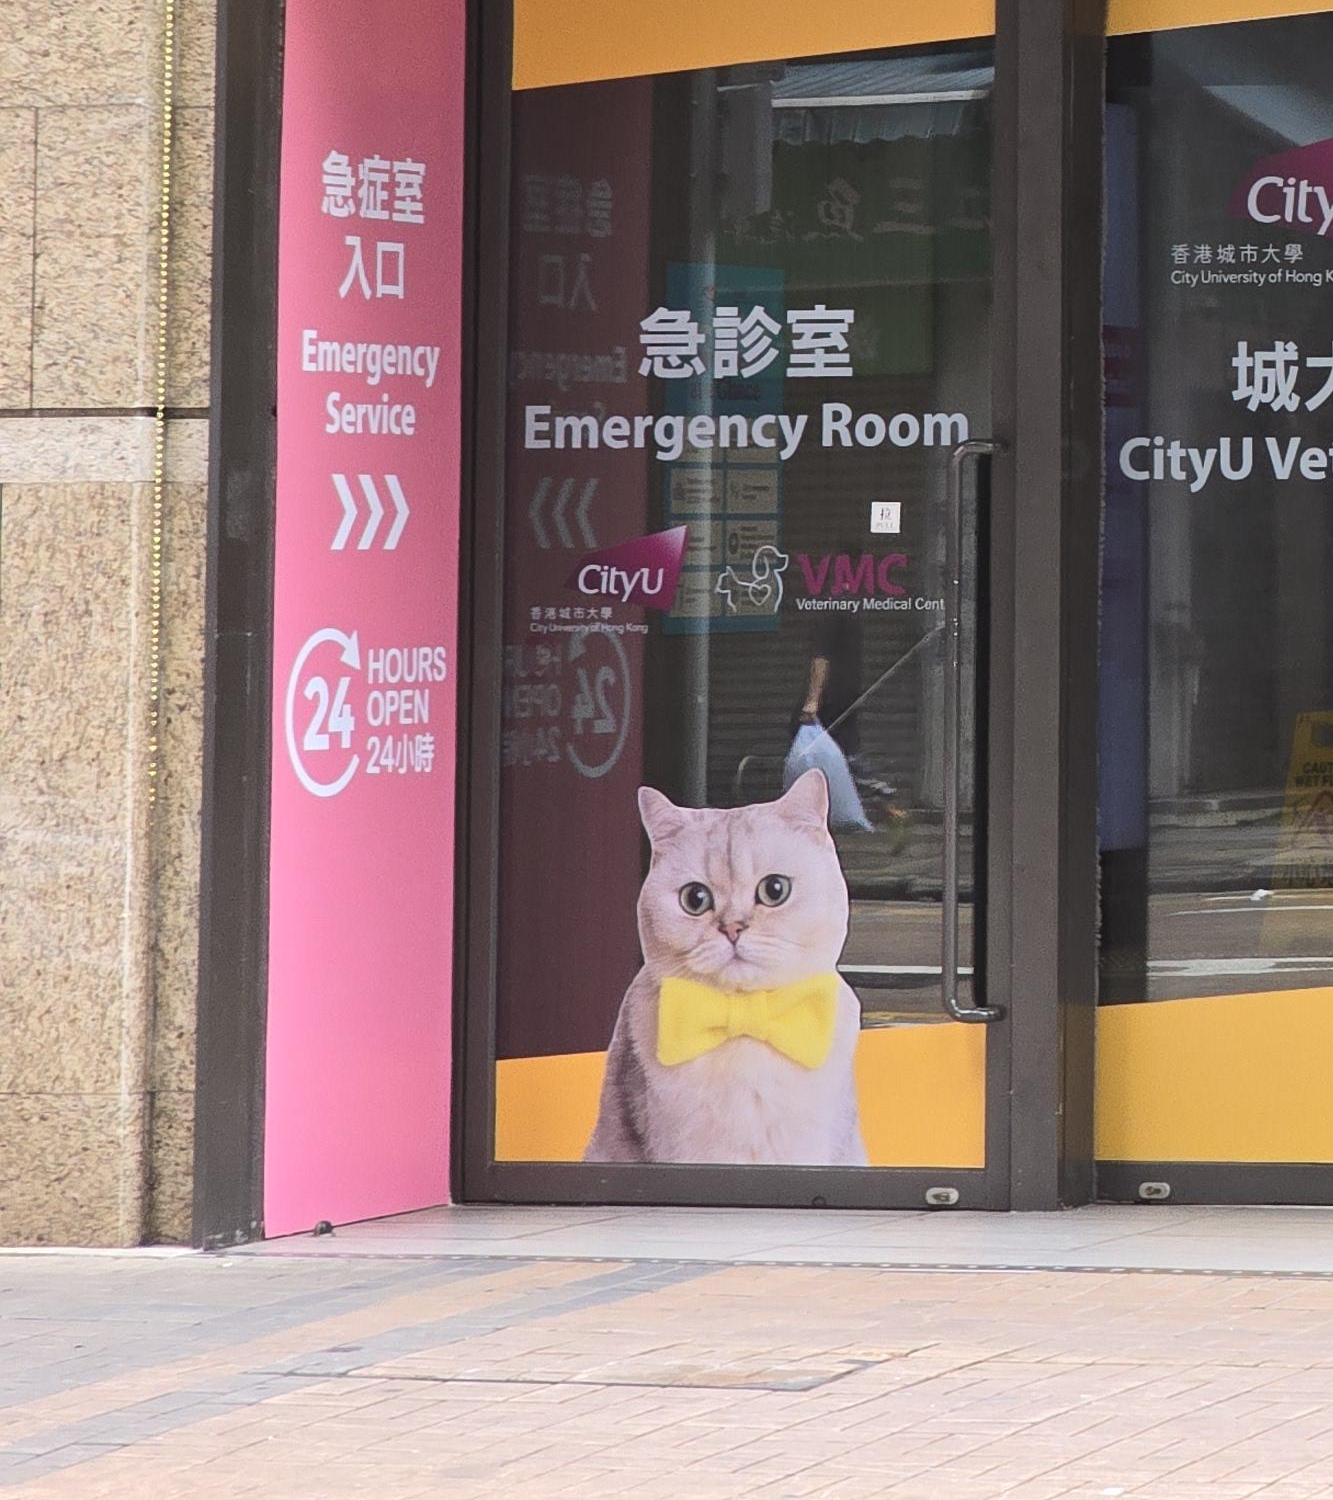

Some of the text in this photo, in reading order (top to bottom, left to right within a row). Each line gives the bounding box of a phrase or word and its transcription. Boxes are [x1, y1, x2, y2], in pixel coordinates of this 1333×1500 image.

[320, 149, 426, 224] 急症室
[338, 235, 405, 300] 入口
[1171, 243, 1304, 265] 香港城市大學
[1170, 270, 1199, 288] City
[1200, 269, 1267, 287] University
[1268, 268, 1283, 283] of
[1285, 269, 1323, 287] Hong
[299, 328, 440, 388] Emergency
[637, 304, 855, 379] 急診室
[324, 391, 416, 436] Service
[524, 402, 968, 463] Emergency Room
[1119, 435, 1253, 493] CityU
[578, 564, 664, 603] CityU
[799, 554, 908, 596] VMC
[530, 606, 613, 621] 香港城市大學
[795, 597, 860, 613] Veterinary
[862, 597, 912, 611] Medical
[367, 646, 447, 685] HOURS
[302, 676, 355, 751] 24
[366, 689, 429, 727] OPEN
[365, 734, 435, 774] 24小時
